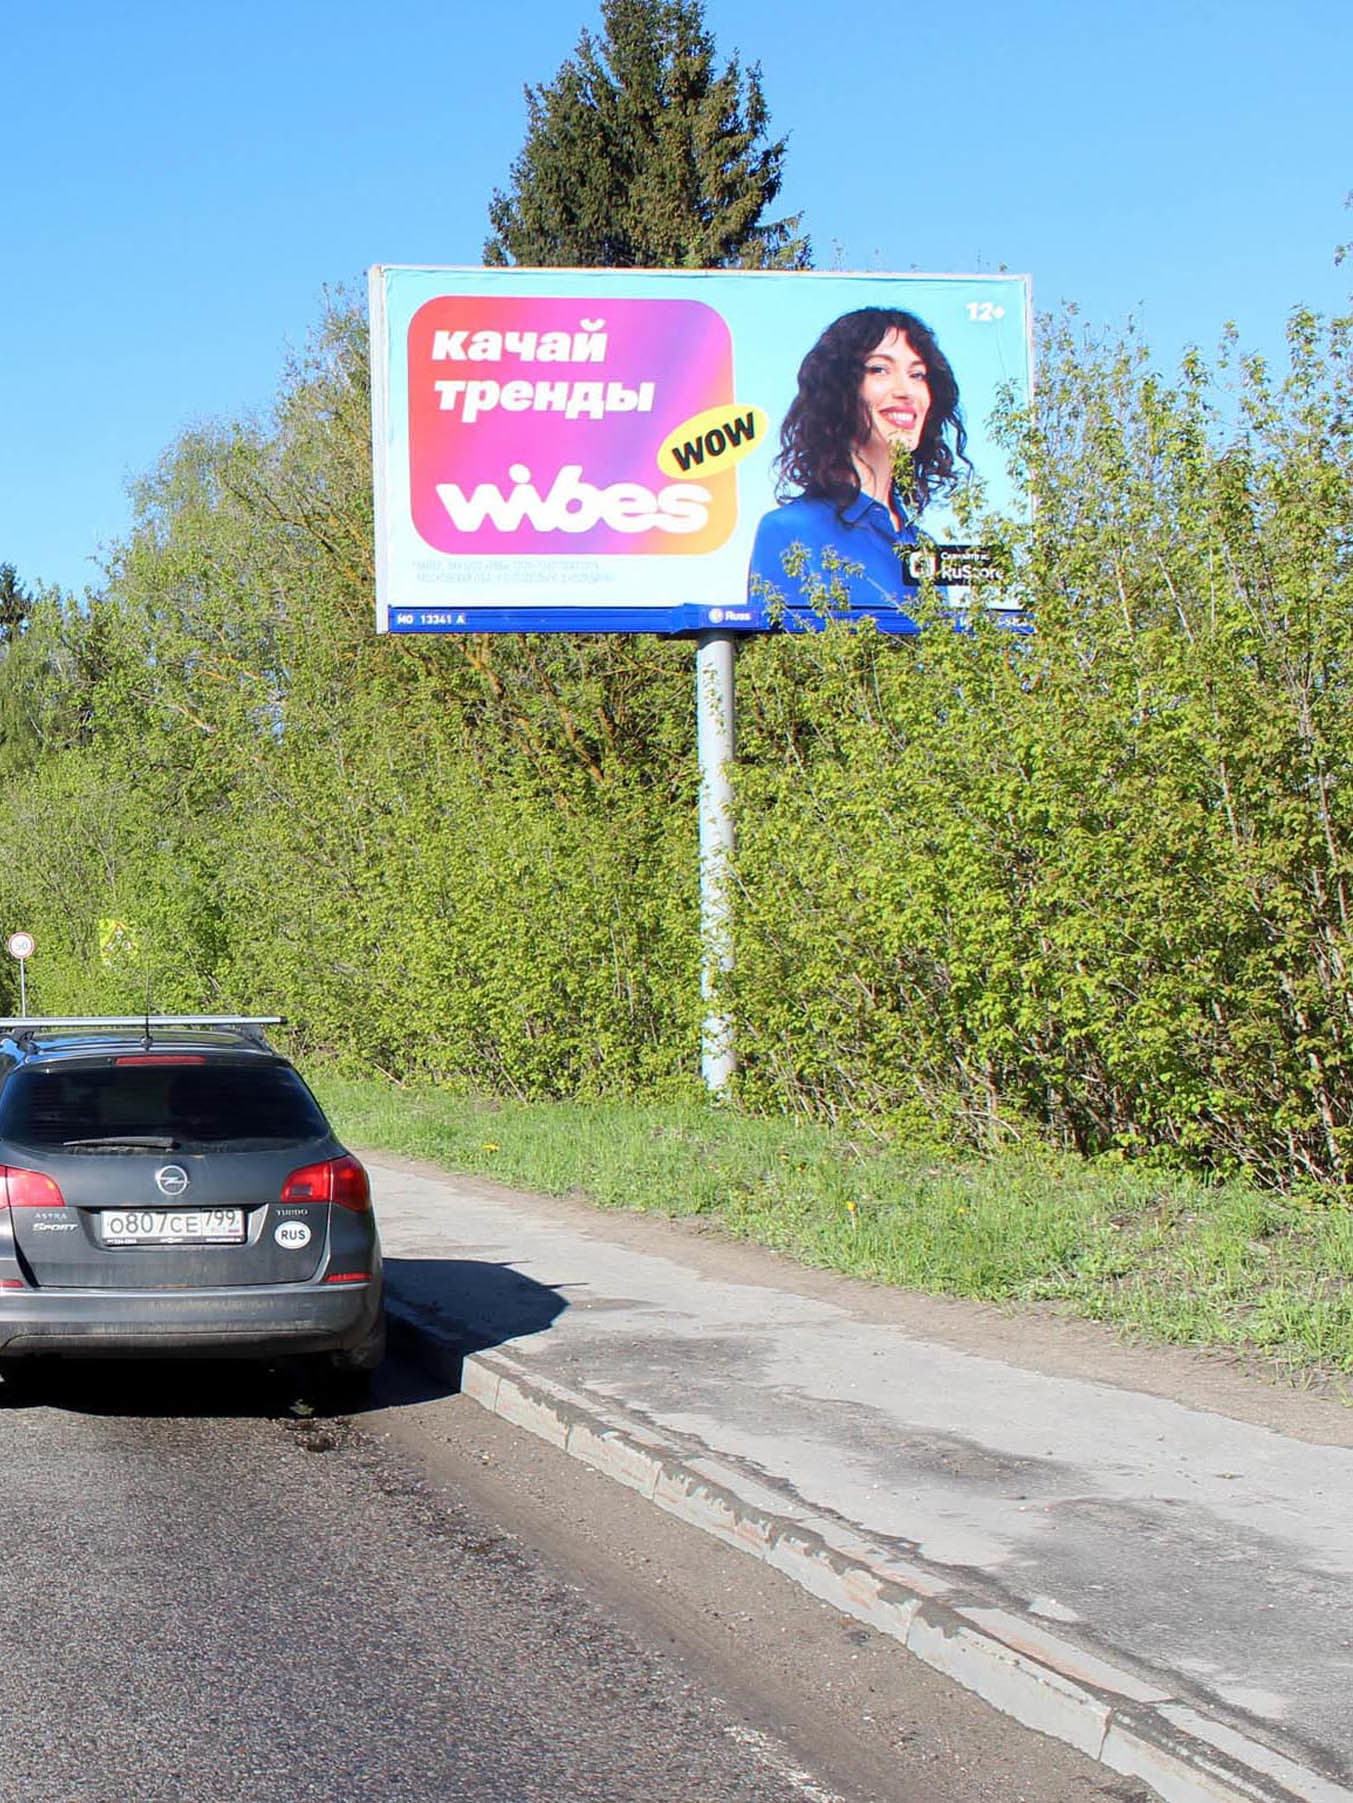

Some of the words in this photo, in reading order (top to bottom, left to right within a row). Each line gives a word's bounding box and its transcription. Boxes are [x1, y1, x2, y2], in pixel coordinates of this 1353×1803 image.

[963, 301, 1005, 320] 12+
[431, 318, 608, 362] качай
[434, 379, 656, 423] тренды
[435, 463, 712, 533] wibes
[281, 1230, 306, 1240] RUS
